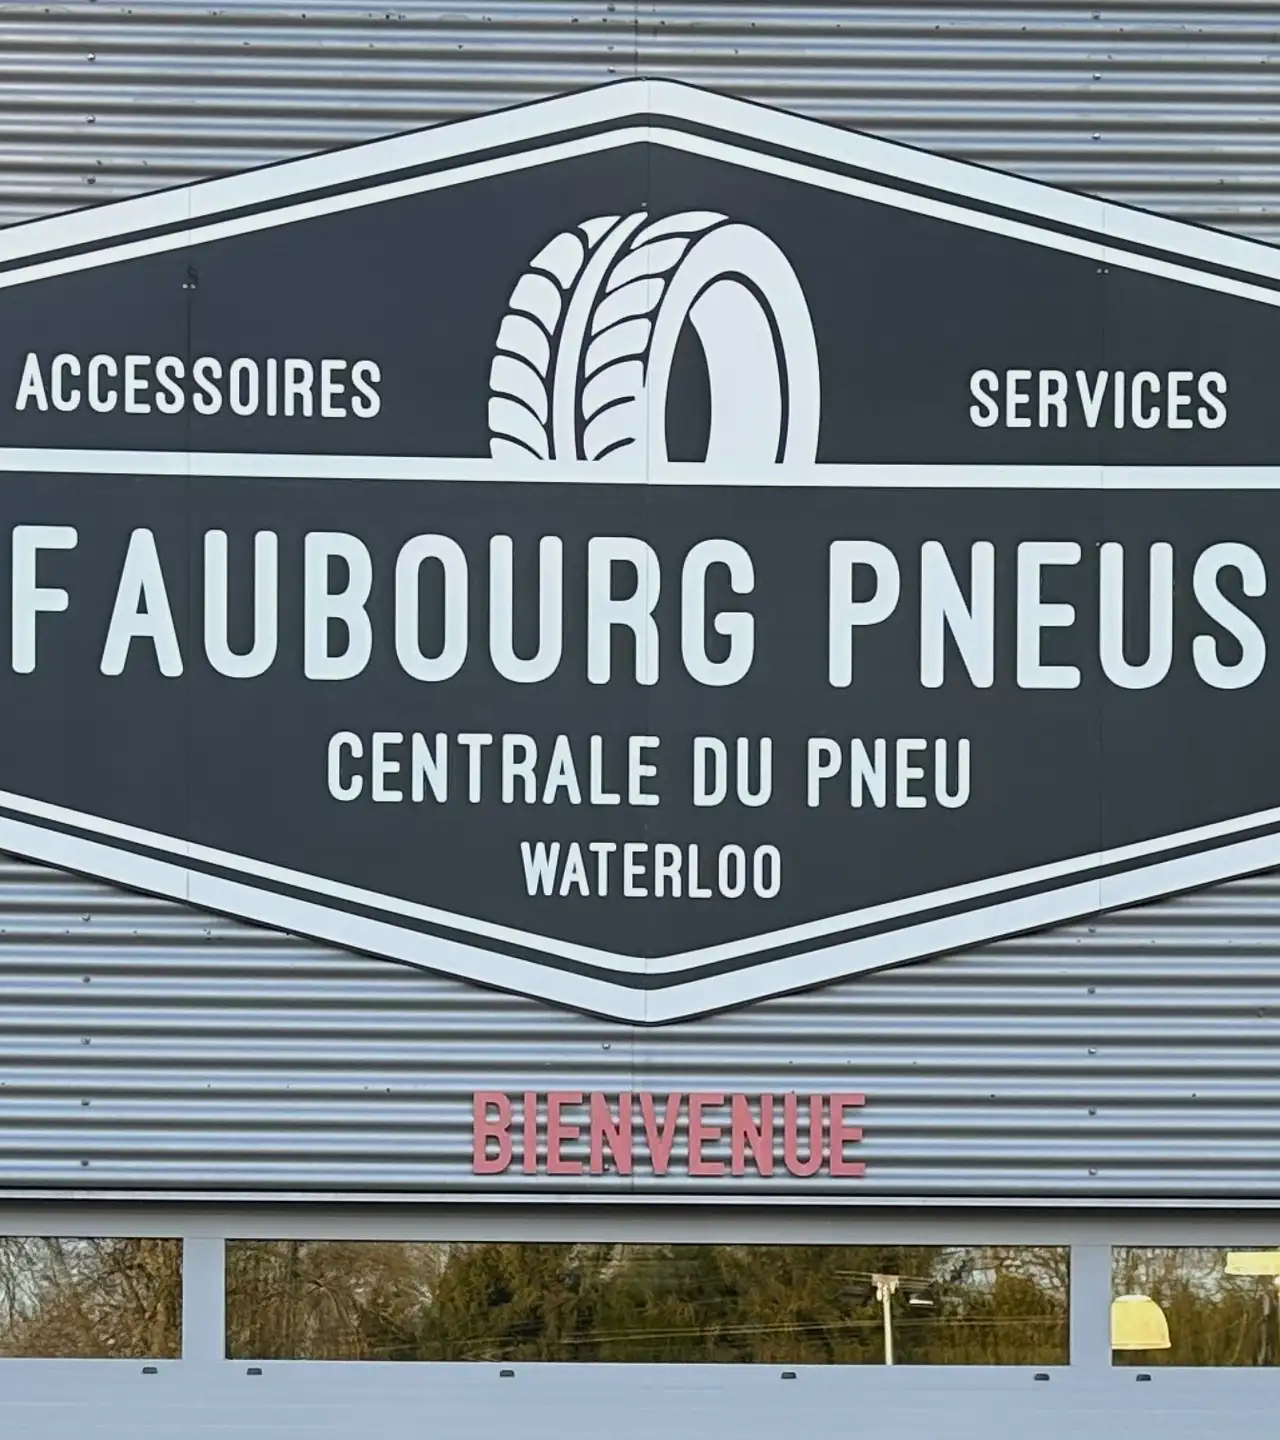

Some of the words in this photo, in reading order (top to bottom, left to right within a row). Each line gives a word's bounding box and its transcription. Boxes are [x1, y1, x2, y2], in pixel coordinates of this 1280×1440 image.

[14, 352, 382, 419] ACCESSOIRES
[968, 369, 1228, 430] SERVICES
[11, 525, 756, 687] FAUBOURG
[827, 540, 1268, 690] PNEUS
[326, 731, 661, 806] CENTRALE
[692, 736, 773, 807] DU
[806, 737, 971, 809] PNEU
[519, 841, 782, 899] WATERLOO
[473, 1091, 866, 1177] BIENVENUE
